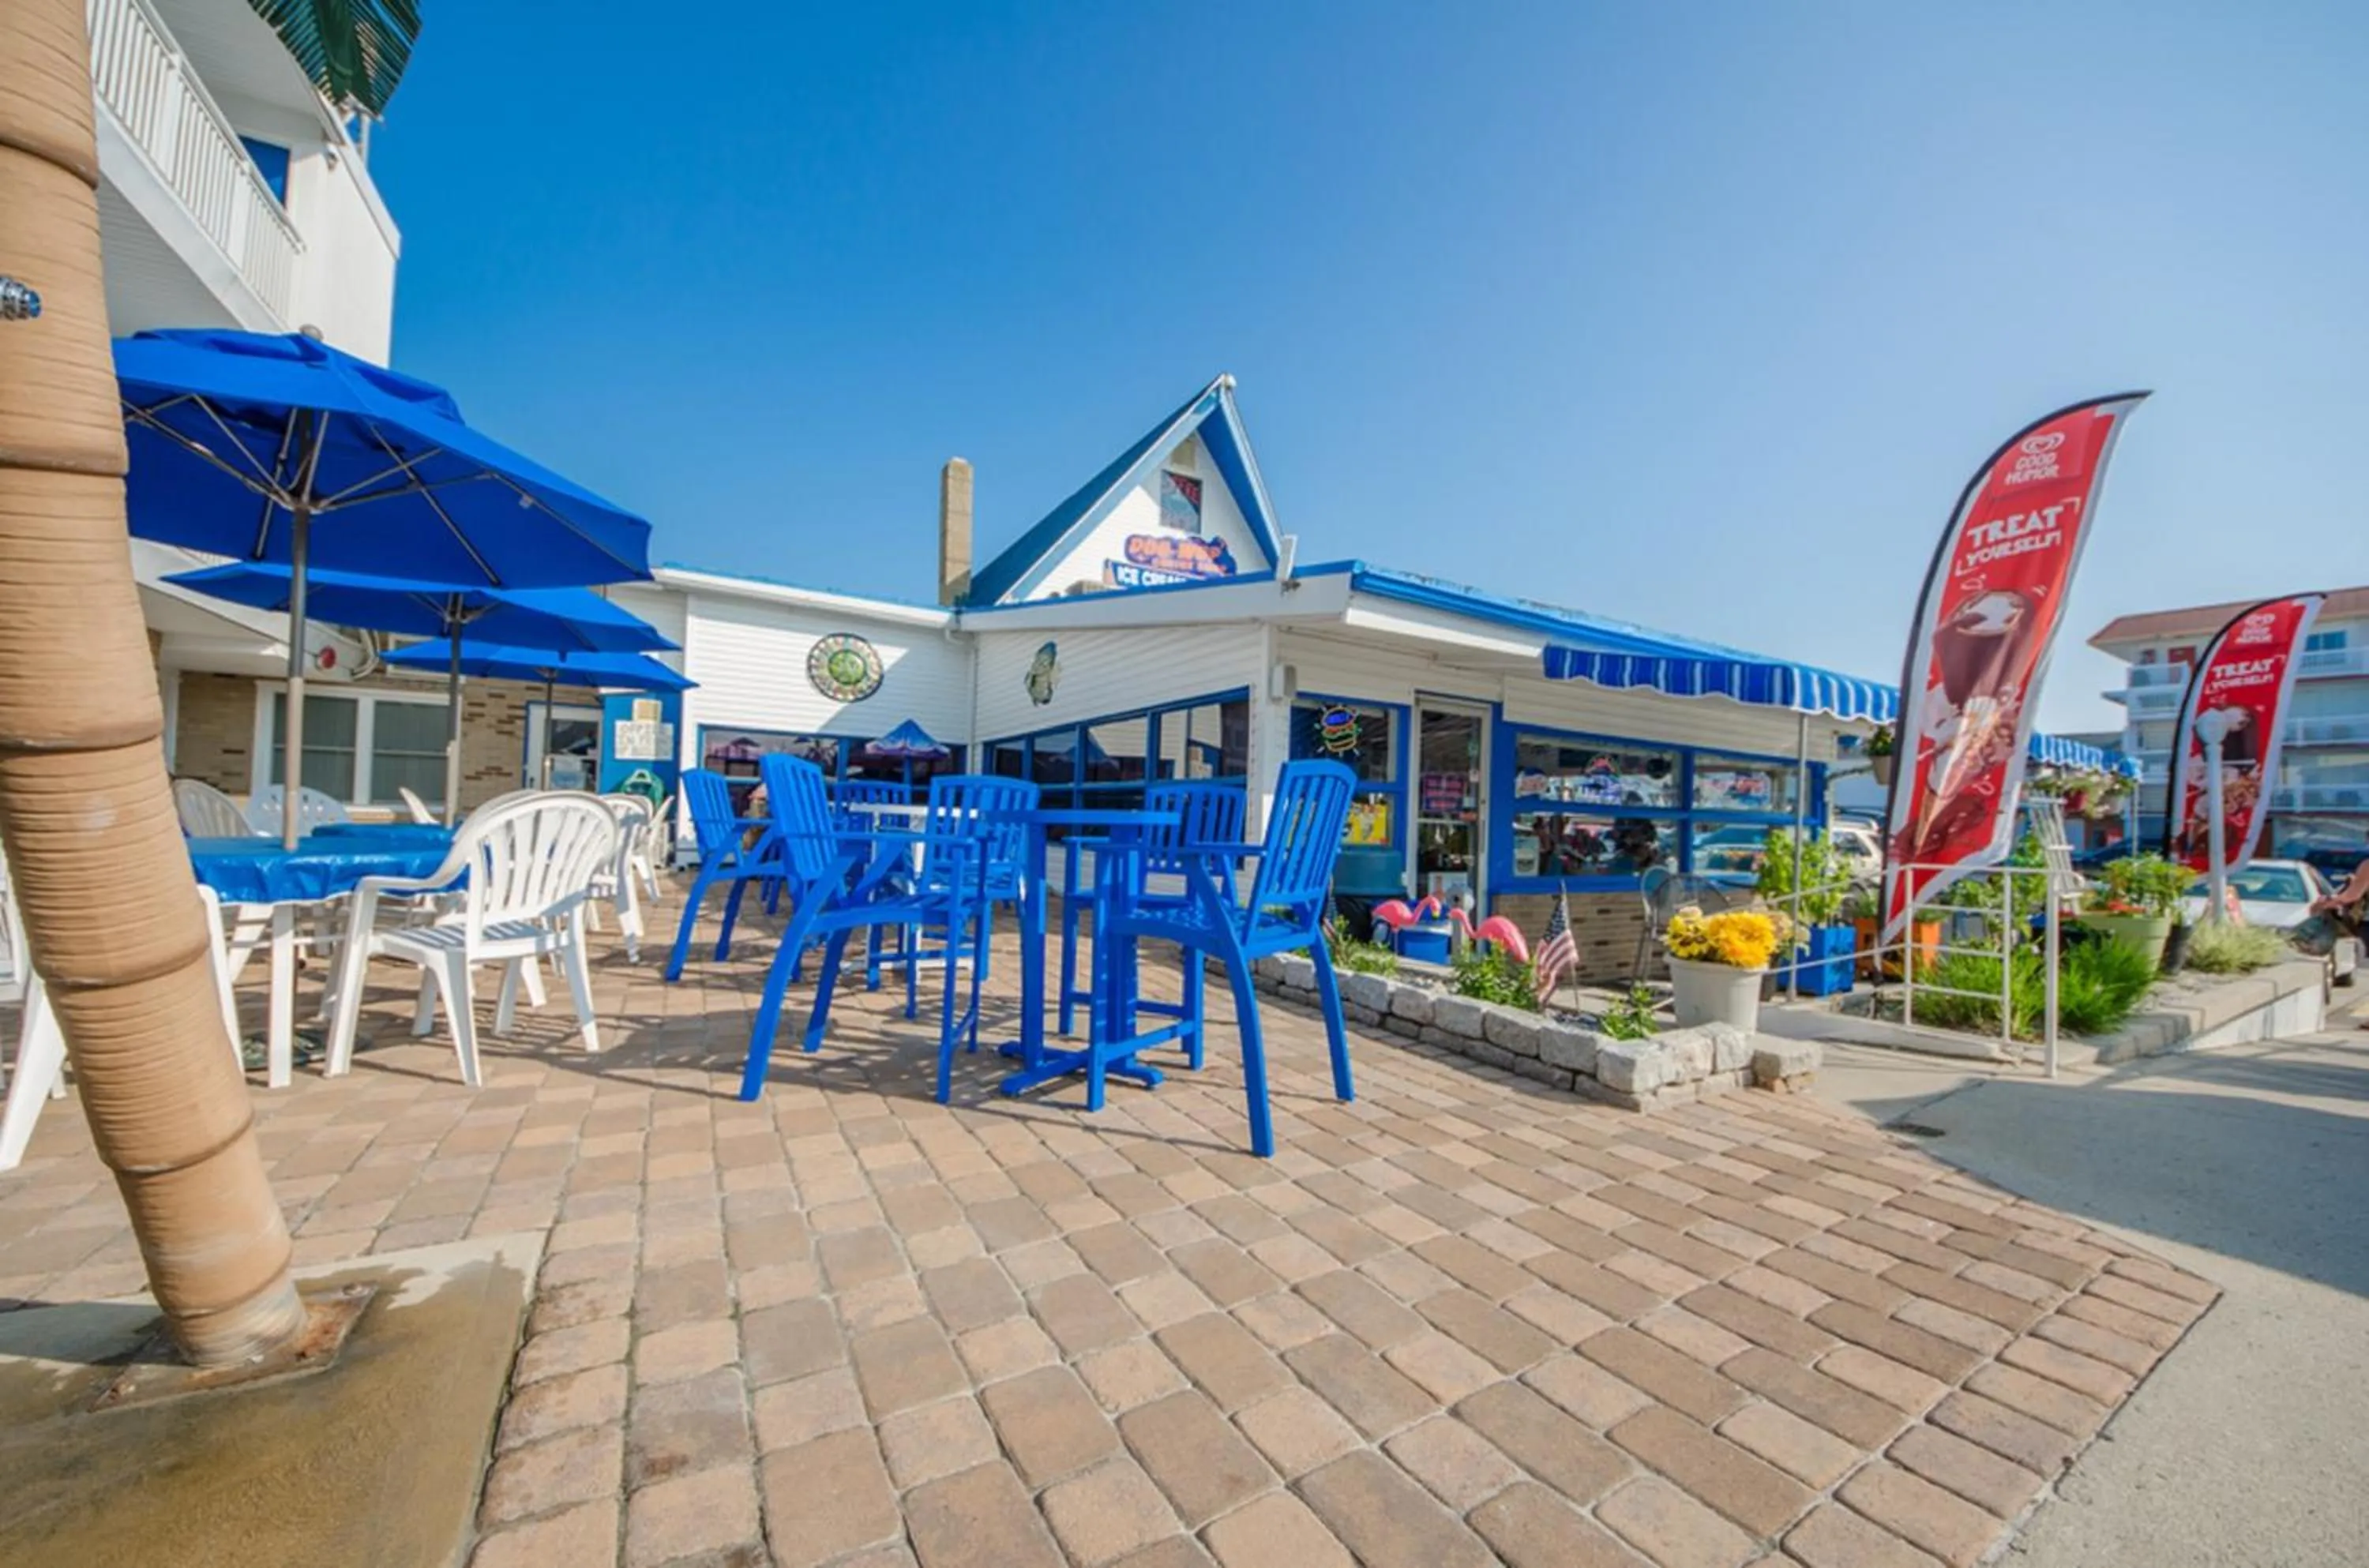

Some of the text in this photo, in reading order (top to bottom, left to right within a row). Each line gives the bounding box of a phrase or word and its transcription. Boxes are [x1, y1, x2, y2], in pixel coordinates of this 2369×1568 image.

[1966, 505, 2064, 548] TREAT
[1966, 531, 2062, 566] YOURSELF
[1117, 566, 1139, 586] ICE
[2212, 658, 2274, 679] TREAT
